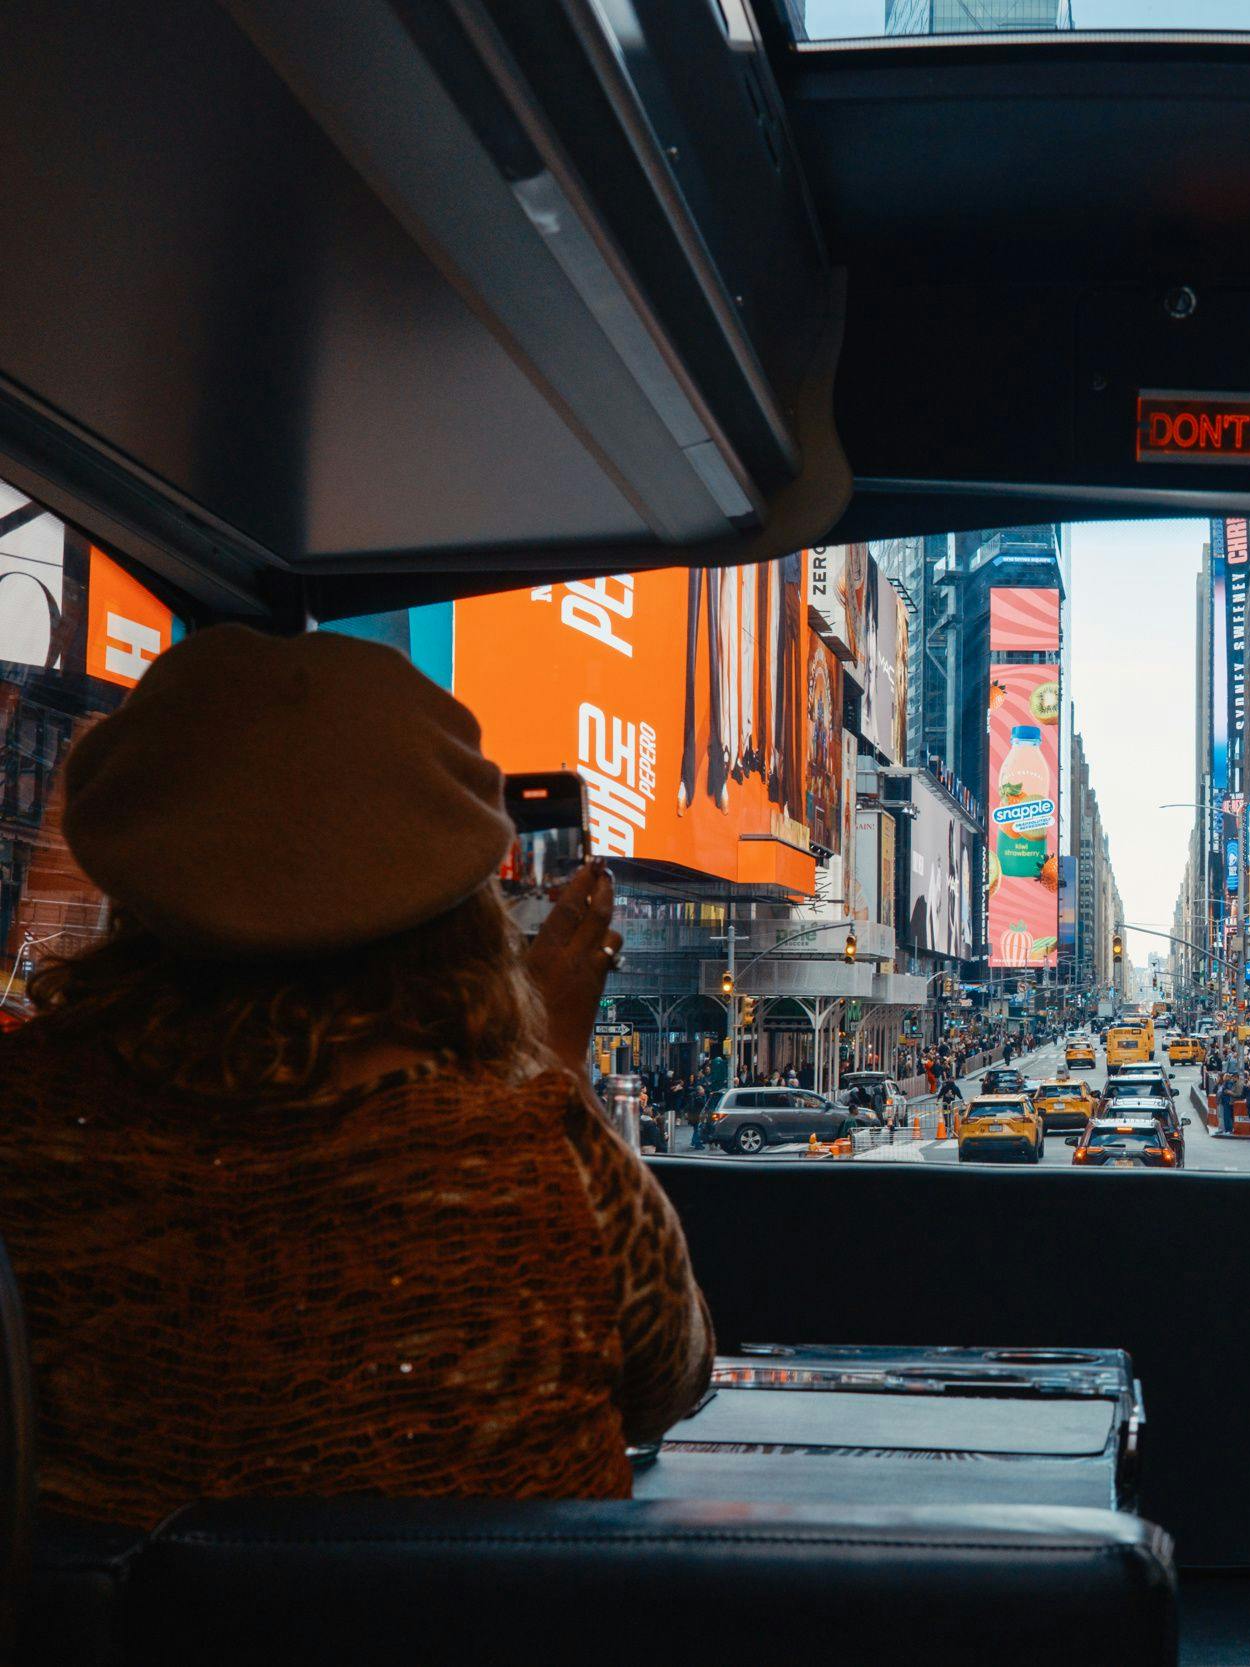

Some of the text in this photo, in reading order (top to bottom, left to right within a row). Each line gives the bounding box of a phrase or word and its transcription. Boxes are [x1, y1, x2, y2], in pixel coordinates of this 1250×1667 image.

[1150, 412, 1250, 448] DON'T
[561, 573, 634, 658] PE
[638, 721, 656, 801] PEPERO
[996, 800, 1052, 821] snapple
[1004, 850, 1040, 858] strawberry
